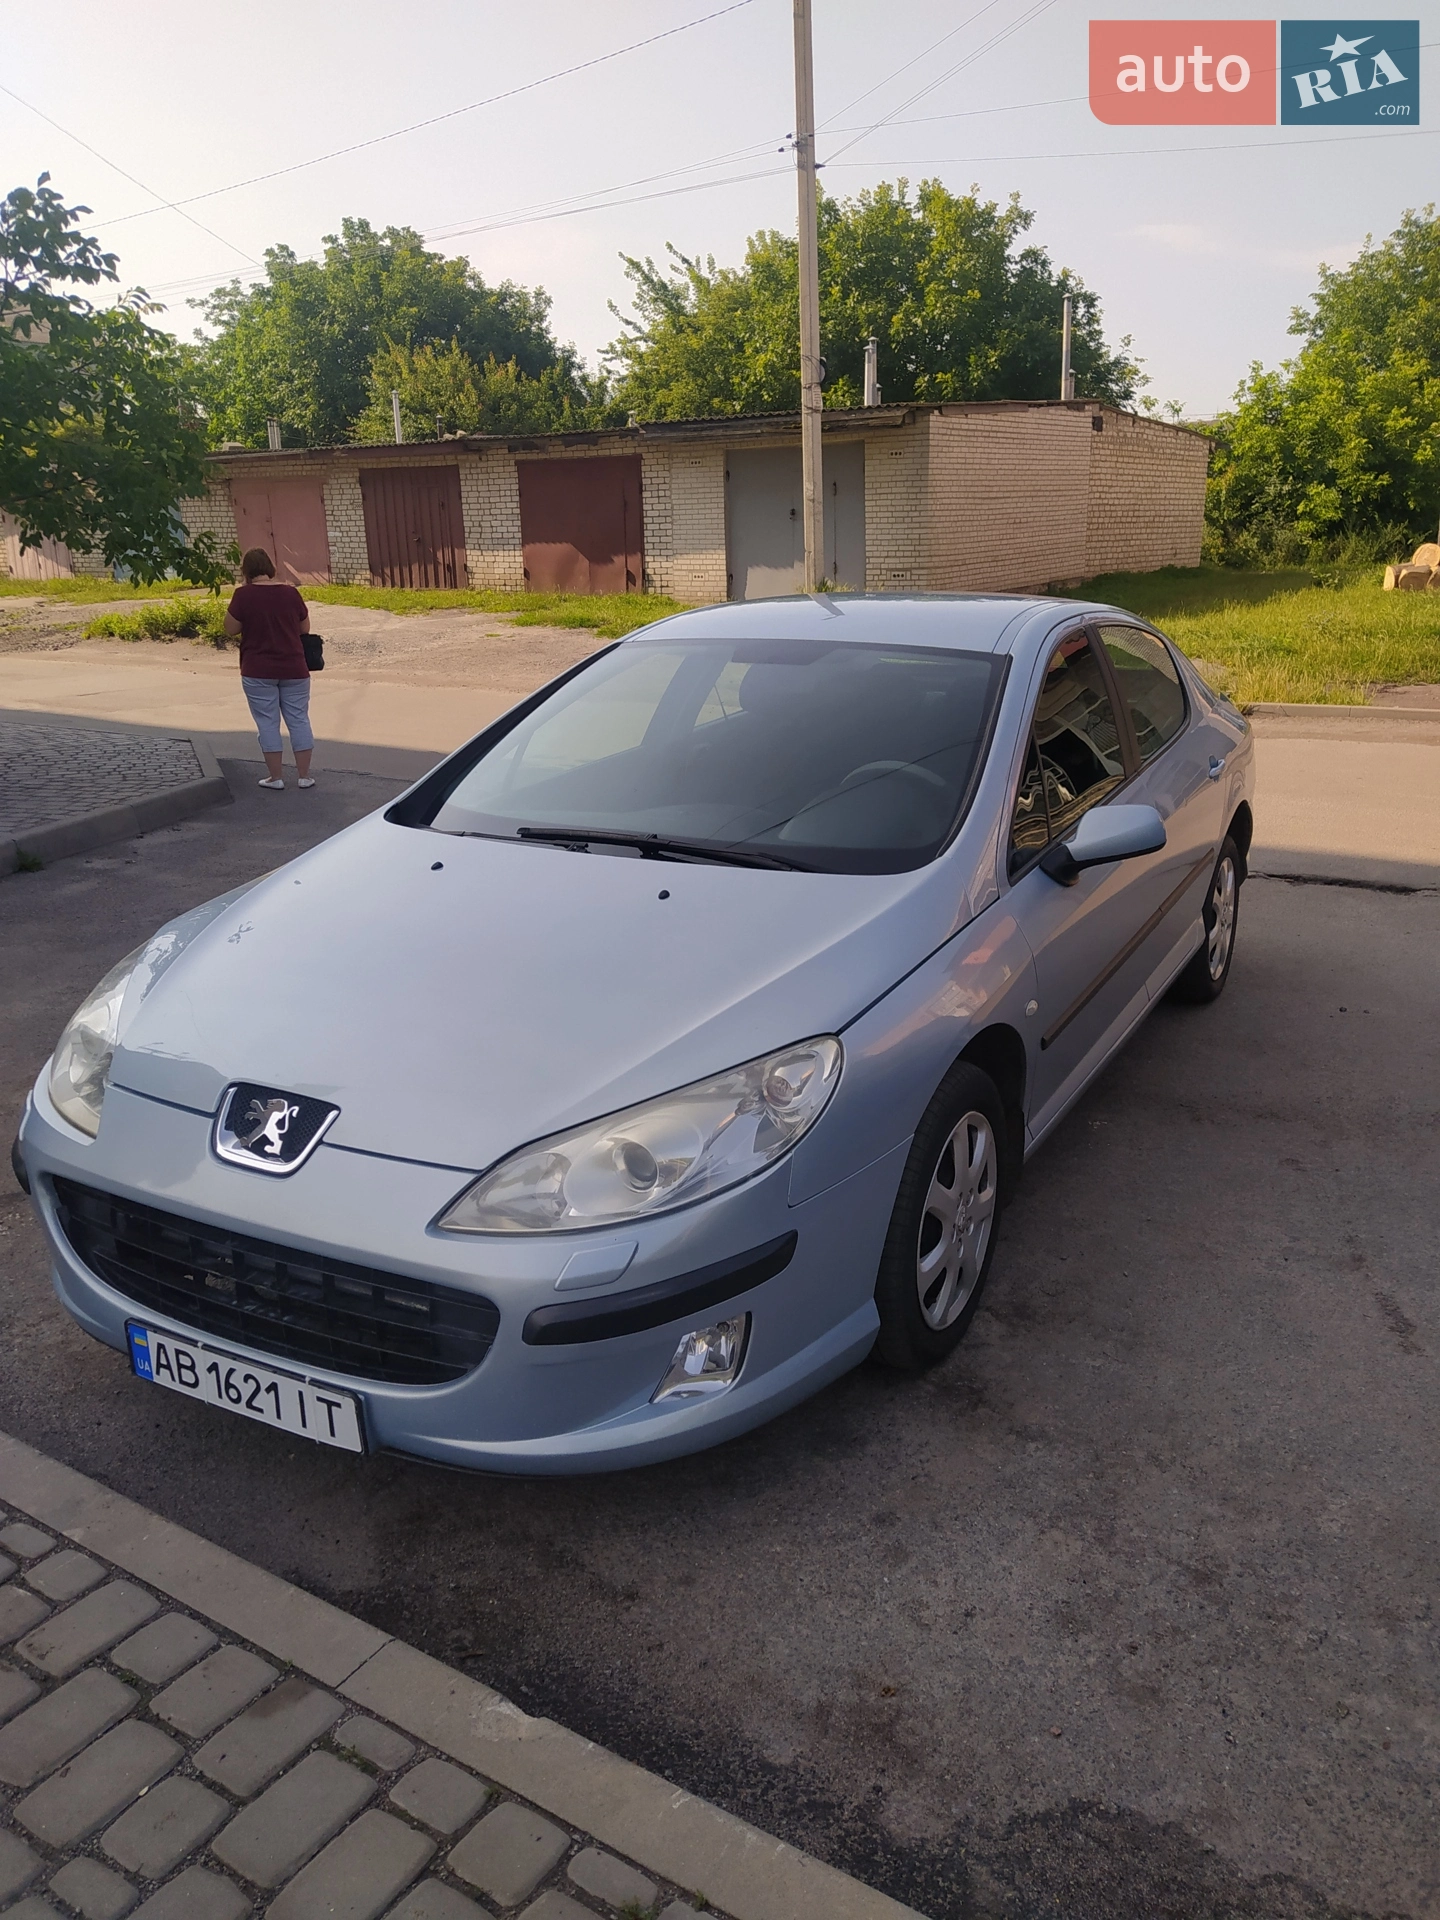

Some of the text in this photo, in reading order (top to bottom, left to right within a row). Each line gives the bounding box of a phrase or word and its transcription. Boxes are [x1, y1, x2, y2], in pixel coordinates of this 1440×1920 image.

[137, 1357, 151, 1373] UA
[155, 1342, 342, 1438] AB 1621 IT
